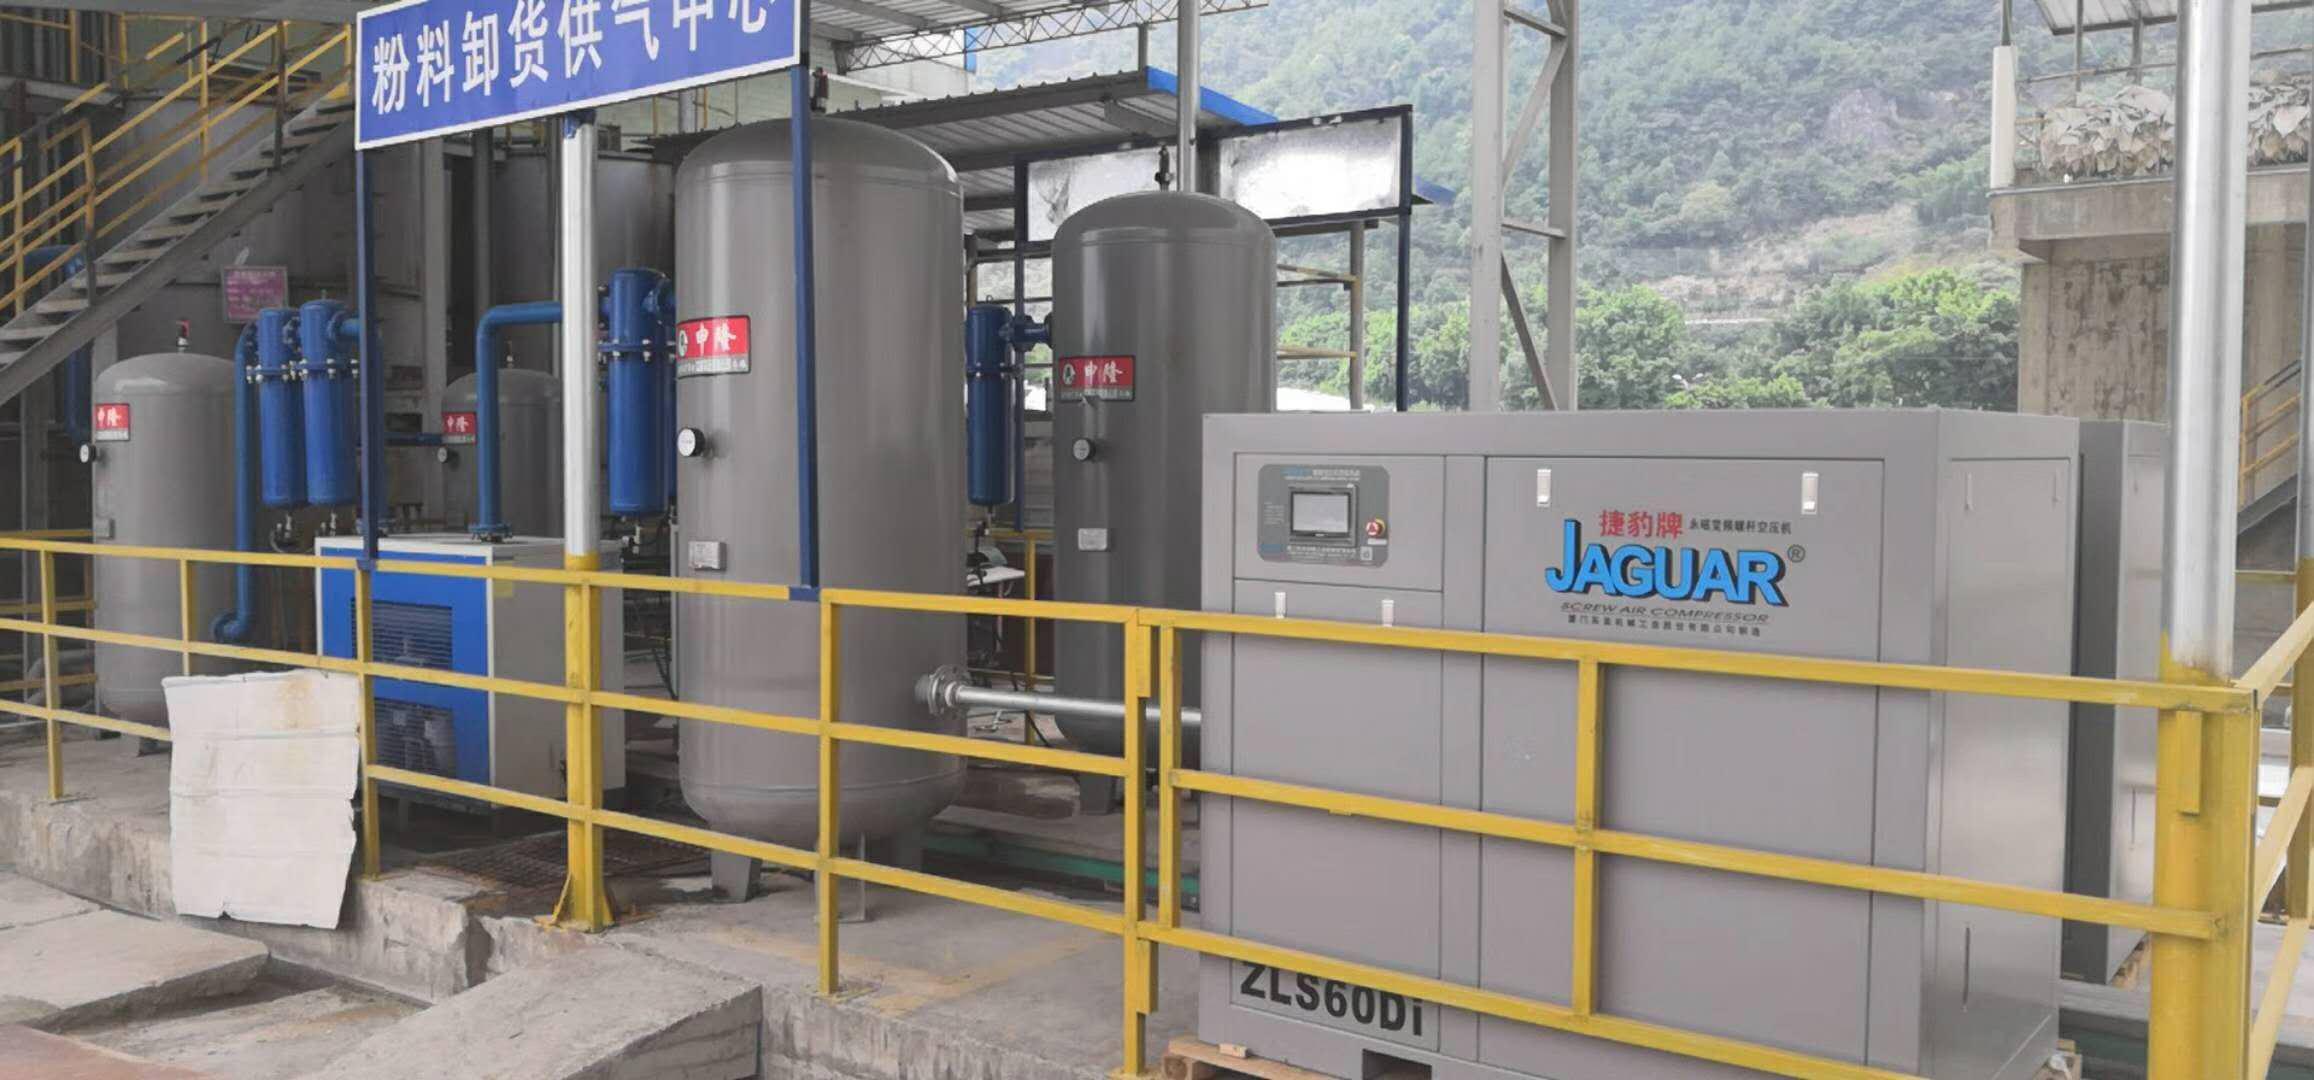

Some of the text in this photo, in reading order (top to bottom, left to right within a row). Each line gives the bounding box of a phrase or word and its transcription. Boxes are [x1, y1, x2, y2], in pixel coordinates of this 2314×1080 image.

[1600, 510, 1684, 539] 捷豹牌
[1545, 518, 1789, 607] JAGUAR
[1560, 602, 1770, 623] SCREW AIR COMPRESSOR
[1240, 961, 1422, 1037] ZLS60Di
